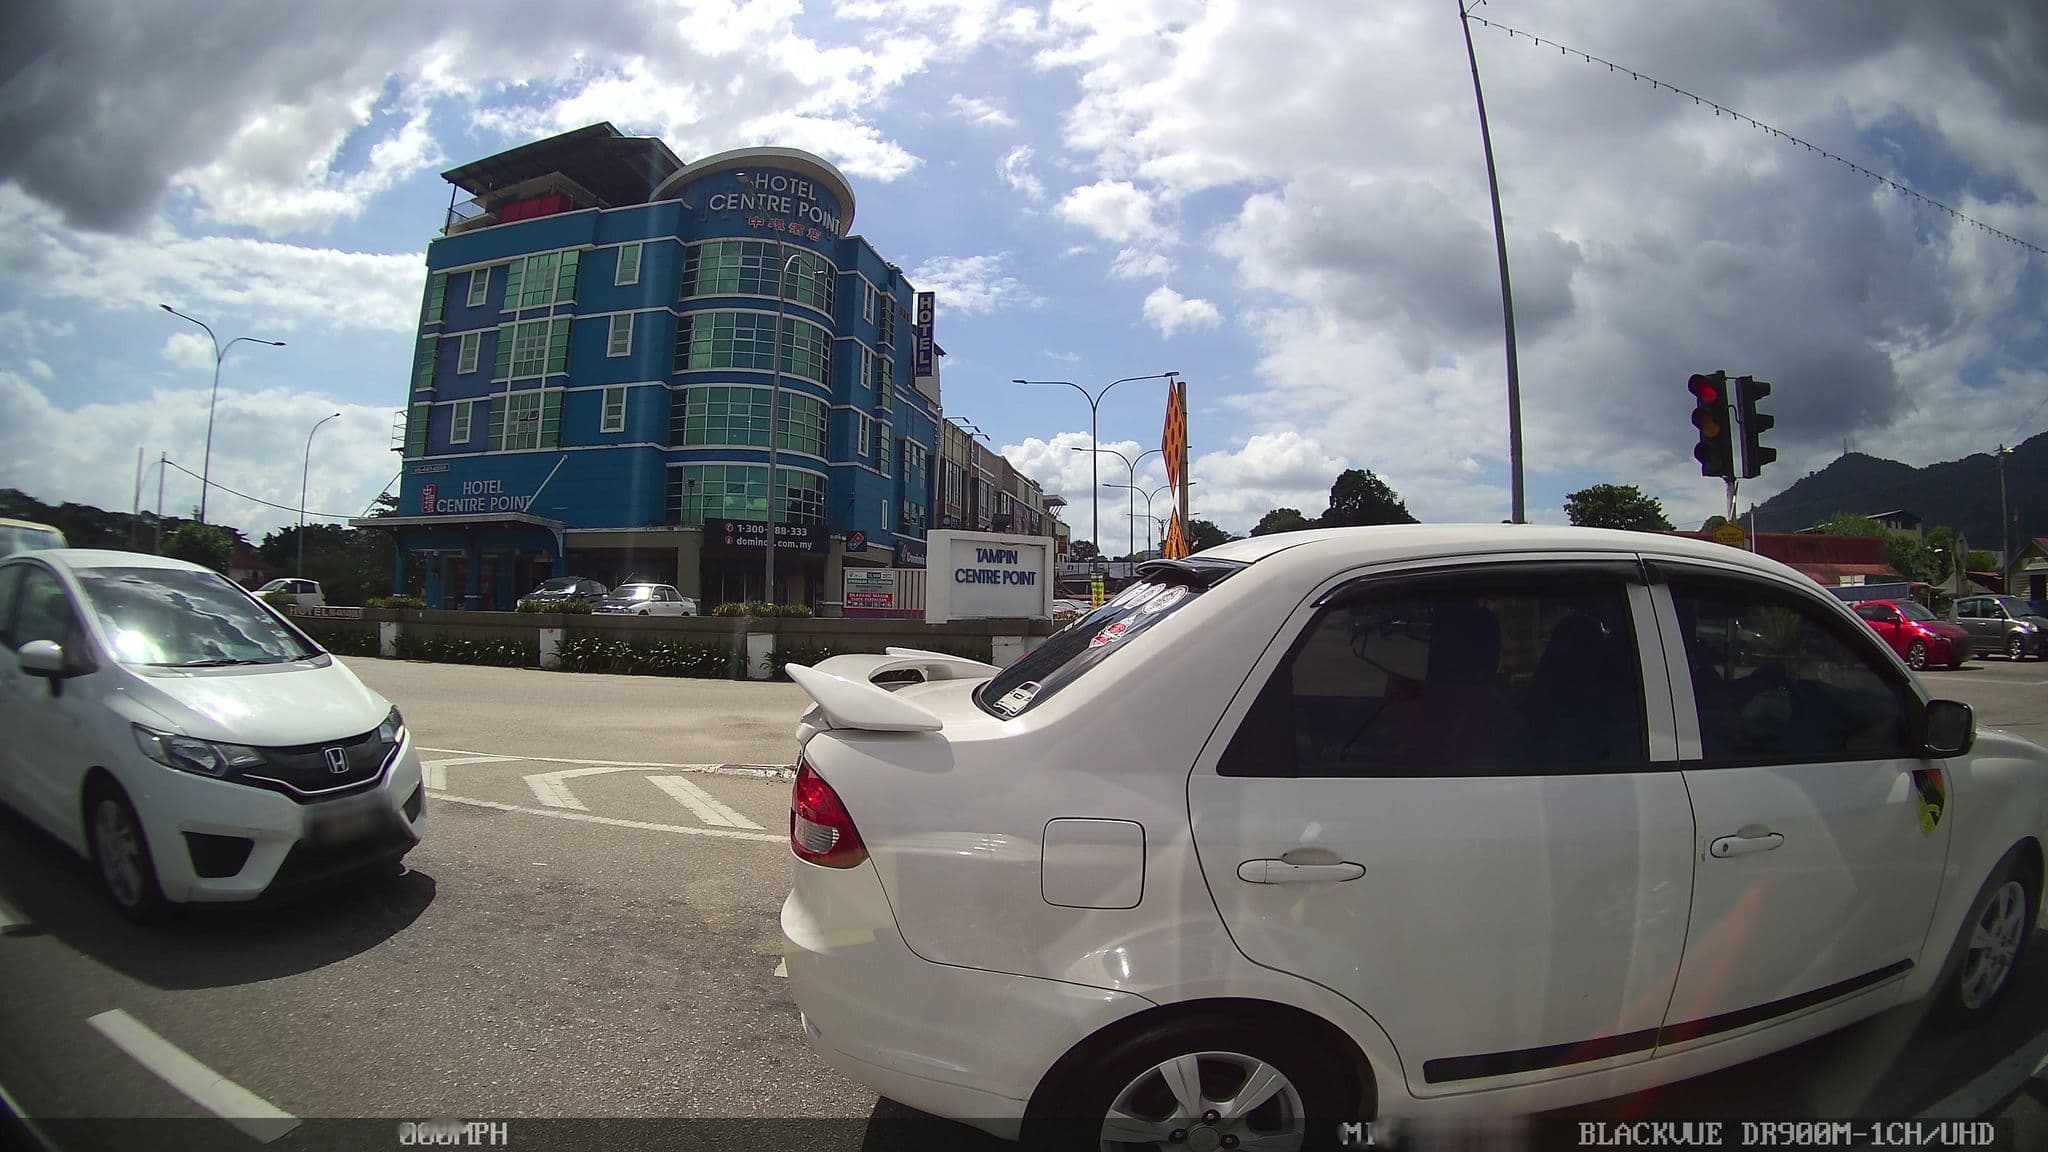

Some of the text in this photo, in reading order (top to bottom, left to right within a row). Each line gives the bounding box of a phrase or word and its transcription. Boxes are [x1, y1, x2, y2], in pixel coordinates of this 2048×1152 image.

[755, 173, 817, 201] HOTEL
[709, 193, 841, 235] CENTRE POINT
[919, 296, 932, 364] HOTEL
[463, 479, 504, 496] HOTEL
[436, 495, 532, 513] CENTRE POINT
[737, 524, 808, 536] 1-300-88-333
[976, 548, 1018, 565] TAMPIN
[955, 568, 1036, 586] CENTRE POINT
